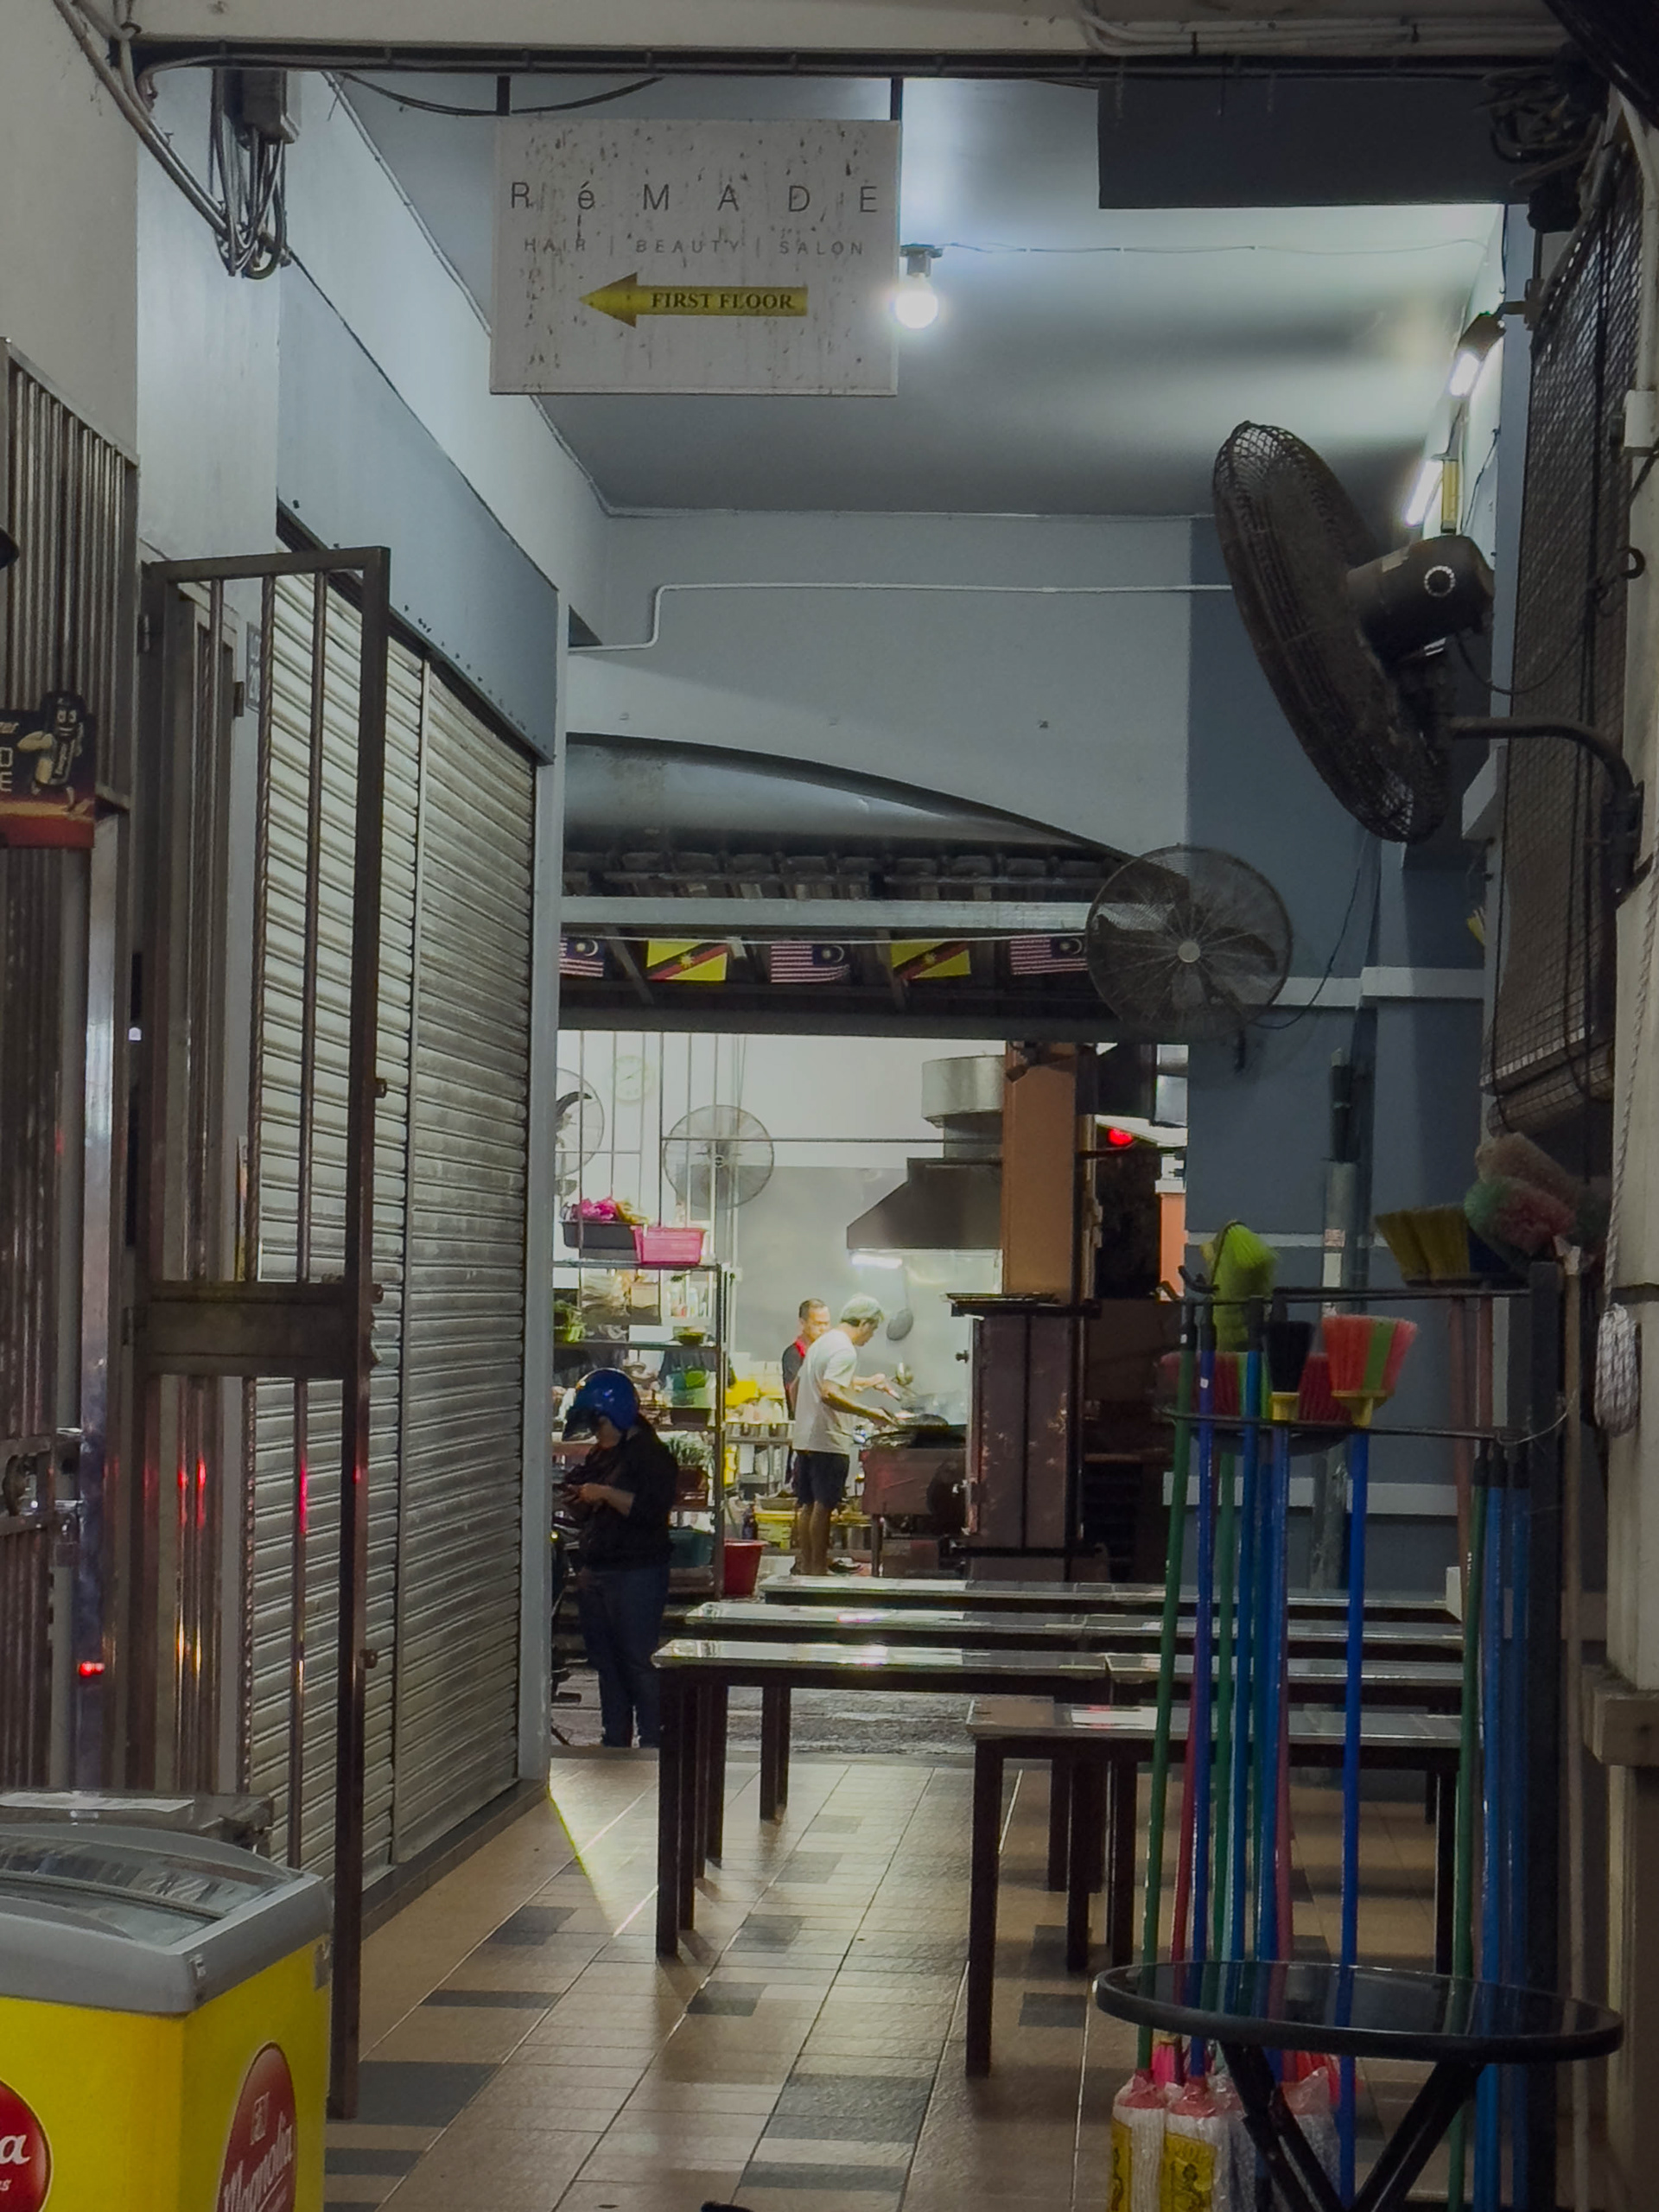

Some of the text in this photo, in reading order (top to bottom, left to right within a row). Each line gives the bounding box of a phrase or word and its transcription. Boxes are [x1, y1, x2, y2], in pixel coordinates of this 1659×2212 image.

[524, 238, 863, 255] HAIR BEAUTY SALON
[652, 292, 795, 309] FIRST FLOOR
